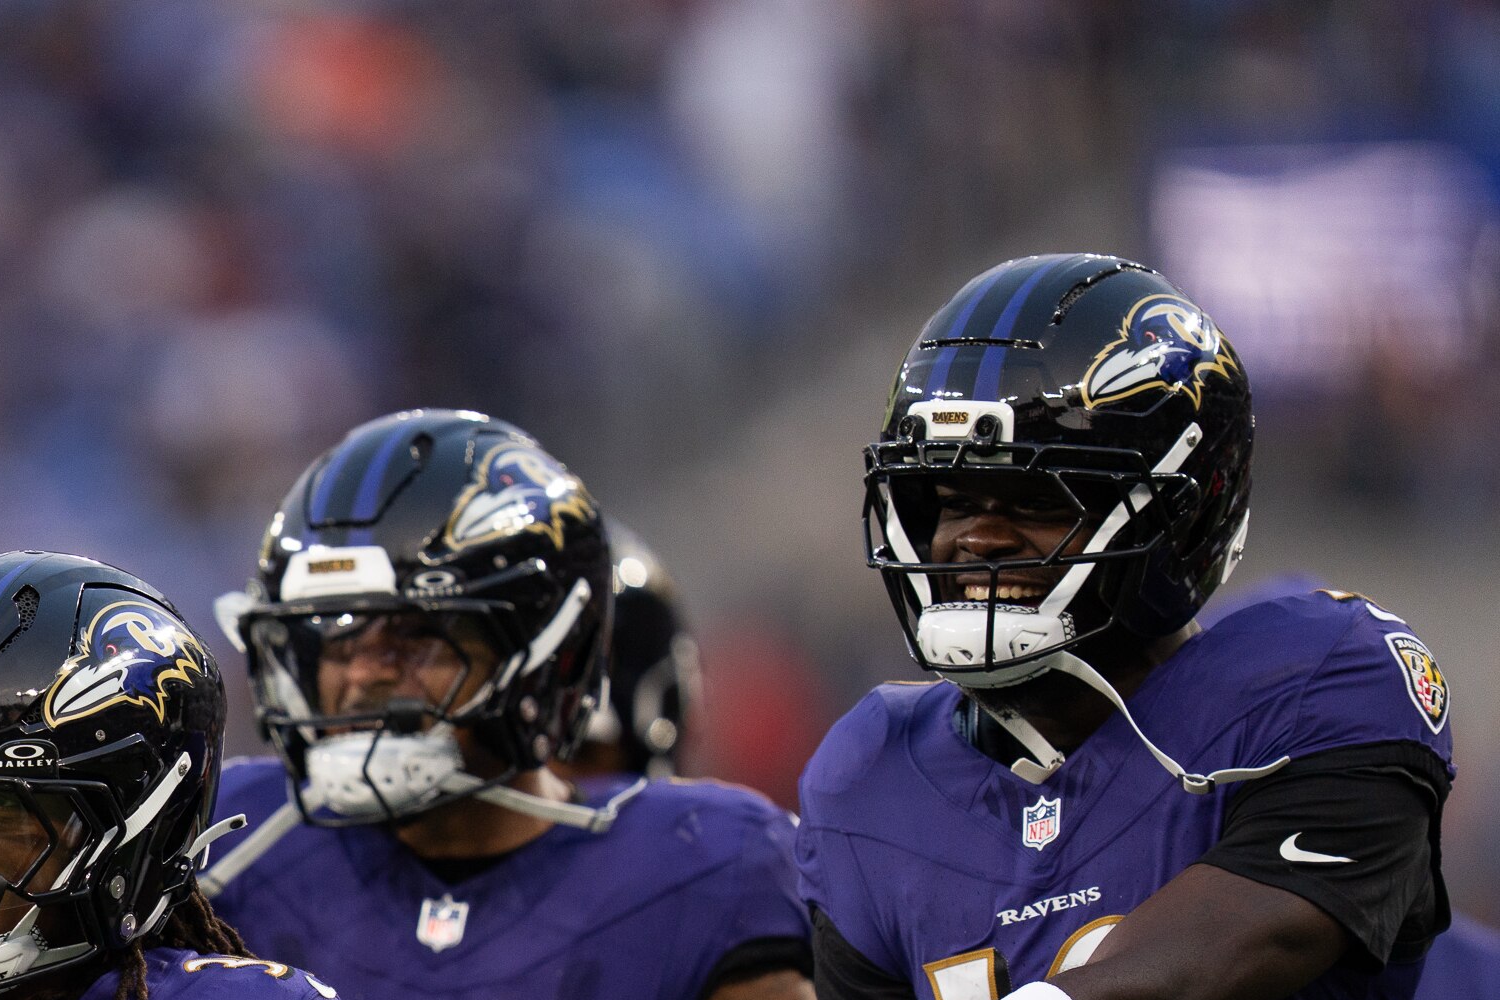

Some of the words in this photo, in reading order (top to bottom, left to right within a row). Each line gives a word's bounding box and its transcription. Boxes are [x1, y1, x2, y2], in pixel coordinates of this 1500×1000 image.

[932, 412, 969, 424] RAVENS
[1029, 819, 1054, 840] NFL
[996, 886, 1102, 926] RAVENS
